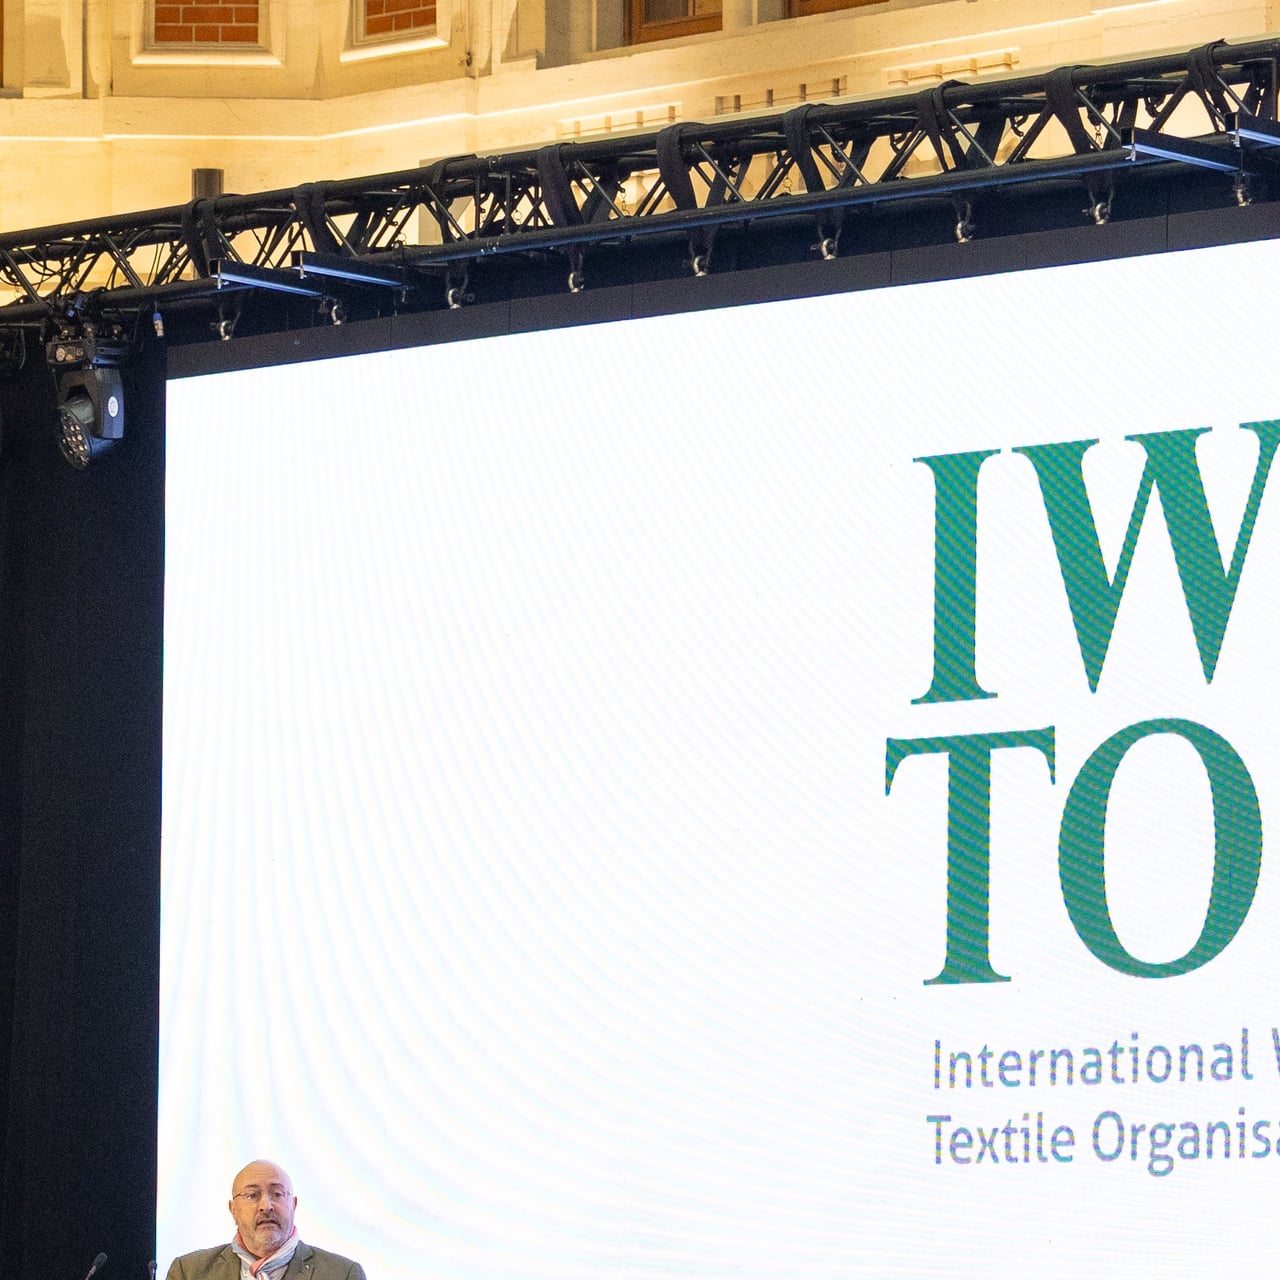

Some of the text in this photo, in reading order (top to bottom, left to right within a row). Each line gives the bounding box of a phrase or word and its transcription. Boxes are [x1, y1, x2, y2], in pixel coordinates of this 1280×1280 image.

[883, 716, 1264, 987] TO
[933, 1026, 1254, 1090] International
[926, 1111, 1076, 1166] Textile
